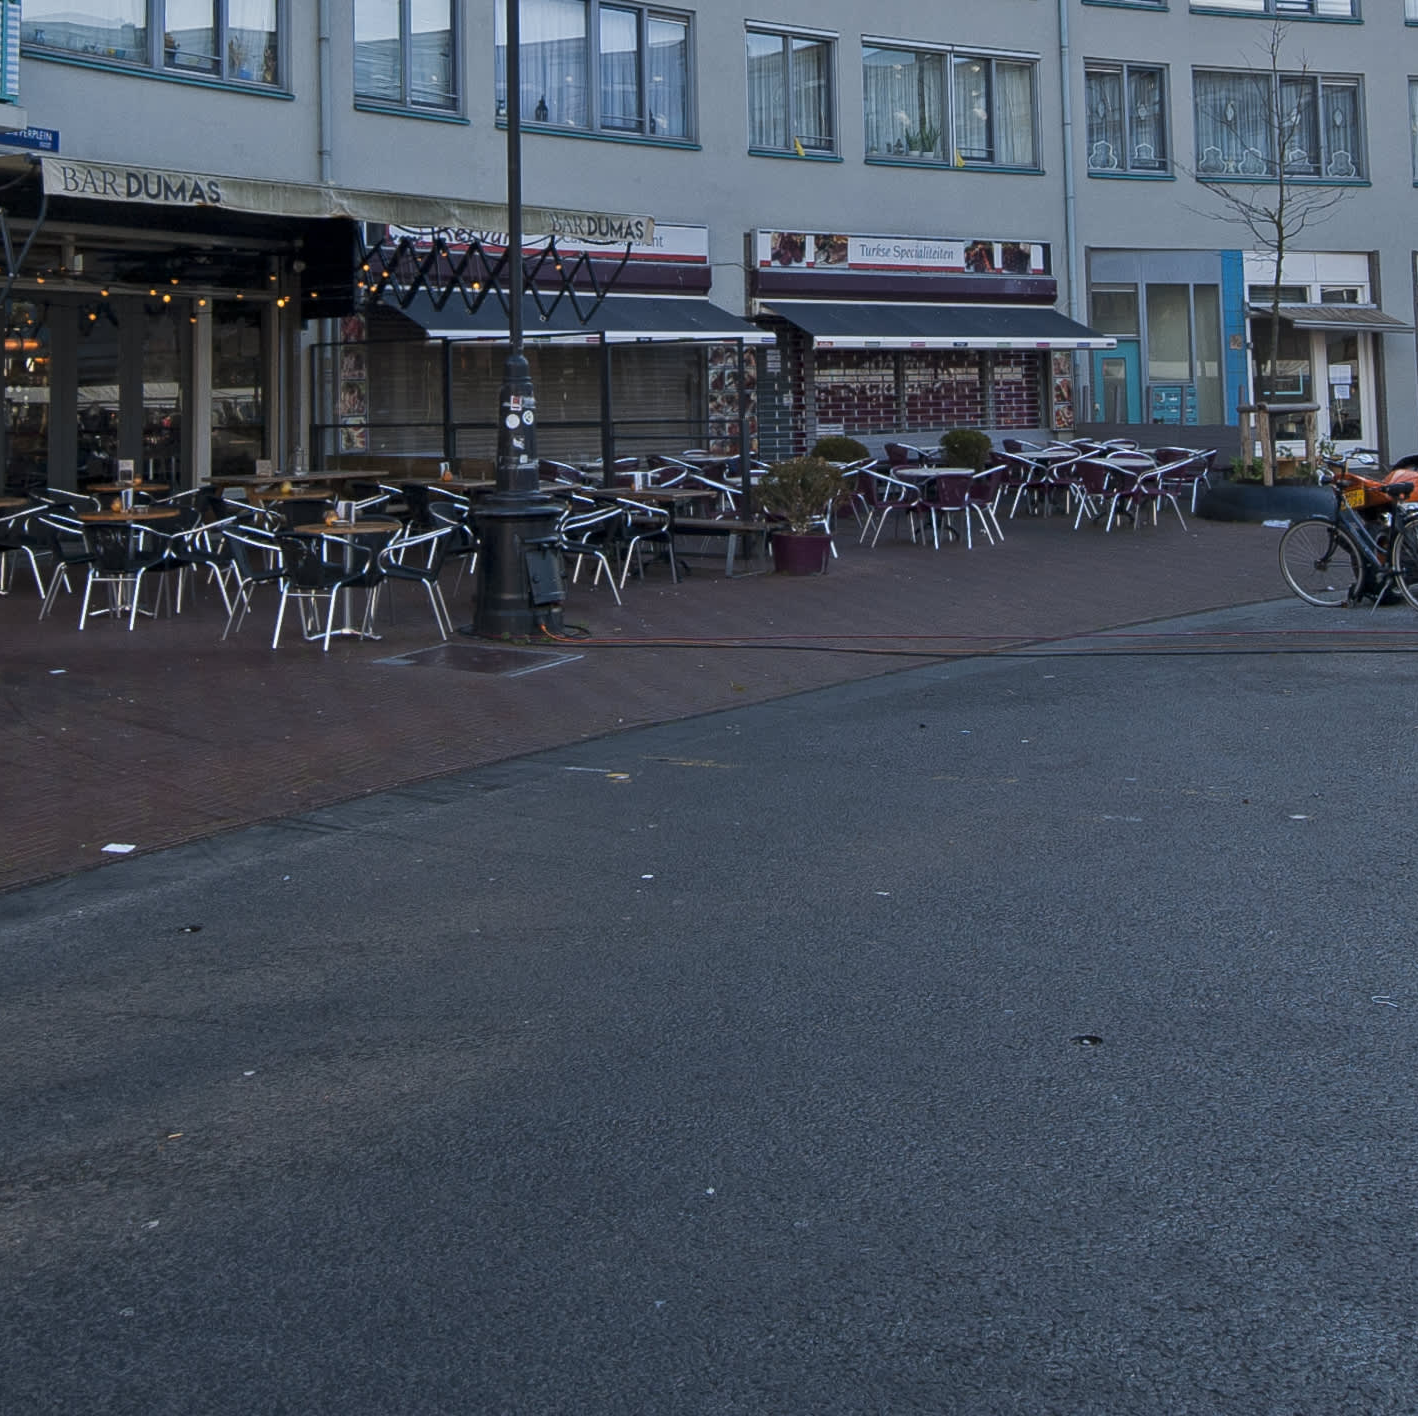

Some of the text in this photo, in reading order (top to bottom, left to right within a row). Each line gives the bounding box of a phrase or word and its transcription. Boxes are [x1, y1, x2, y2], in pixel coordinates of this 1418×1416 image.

[60, 166, 222, 204] BAR DUMAS
[549, 213, 644, 241] BAR DUMAS
[859, 243, 955, 261] Turkse Specialiteiten
